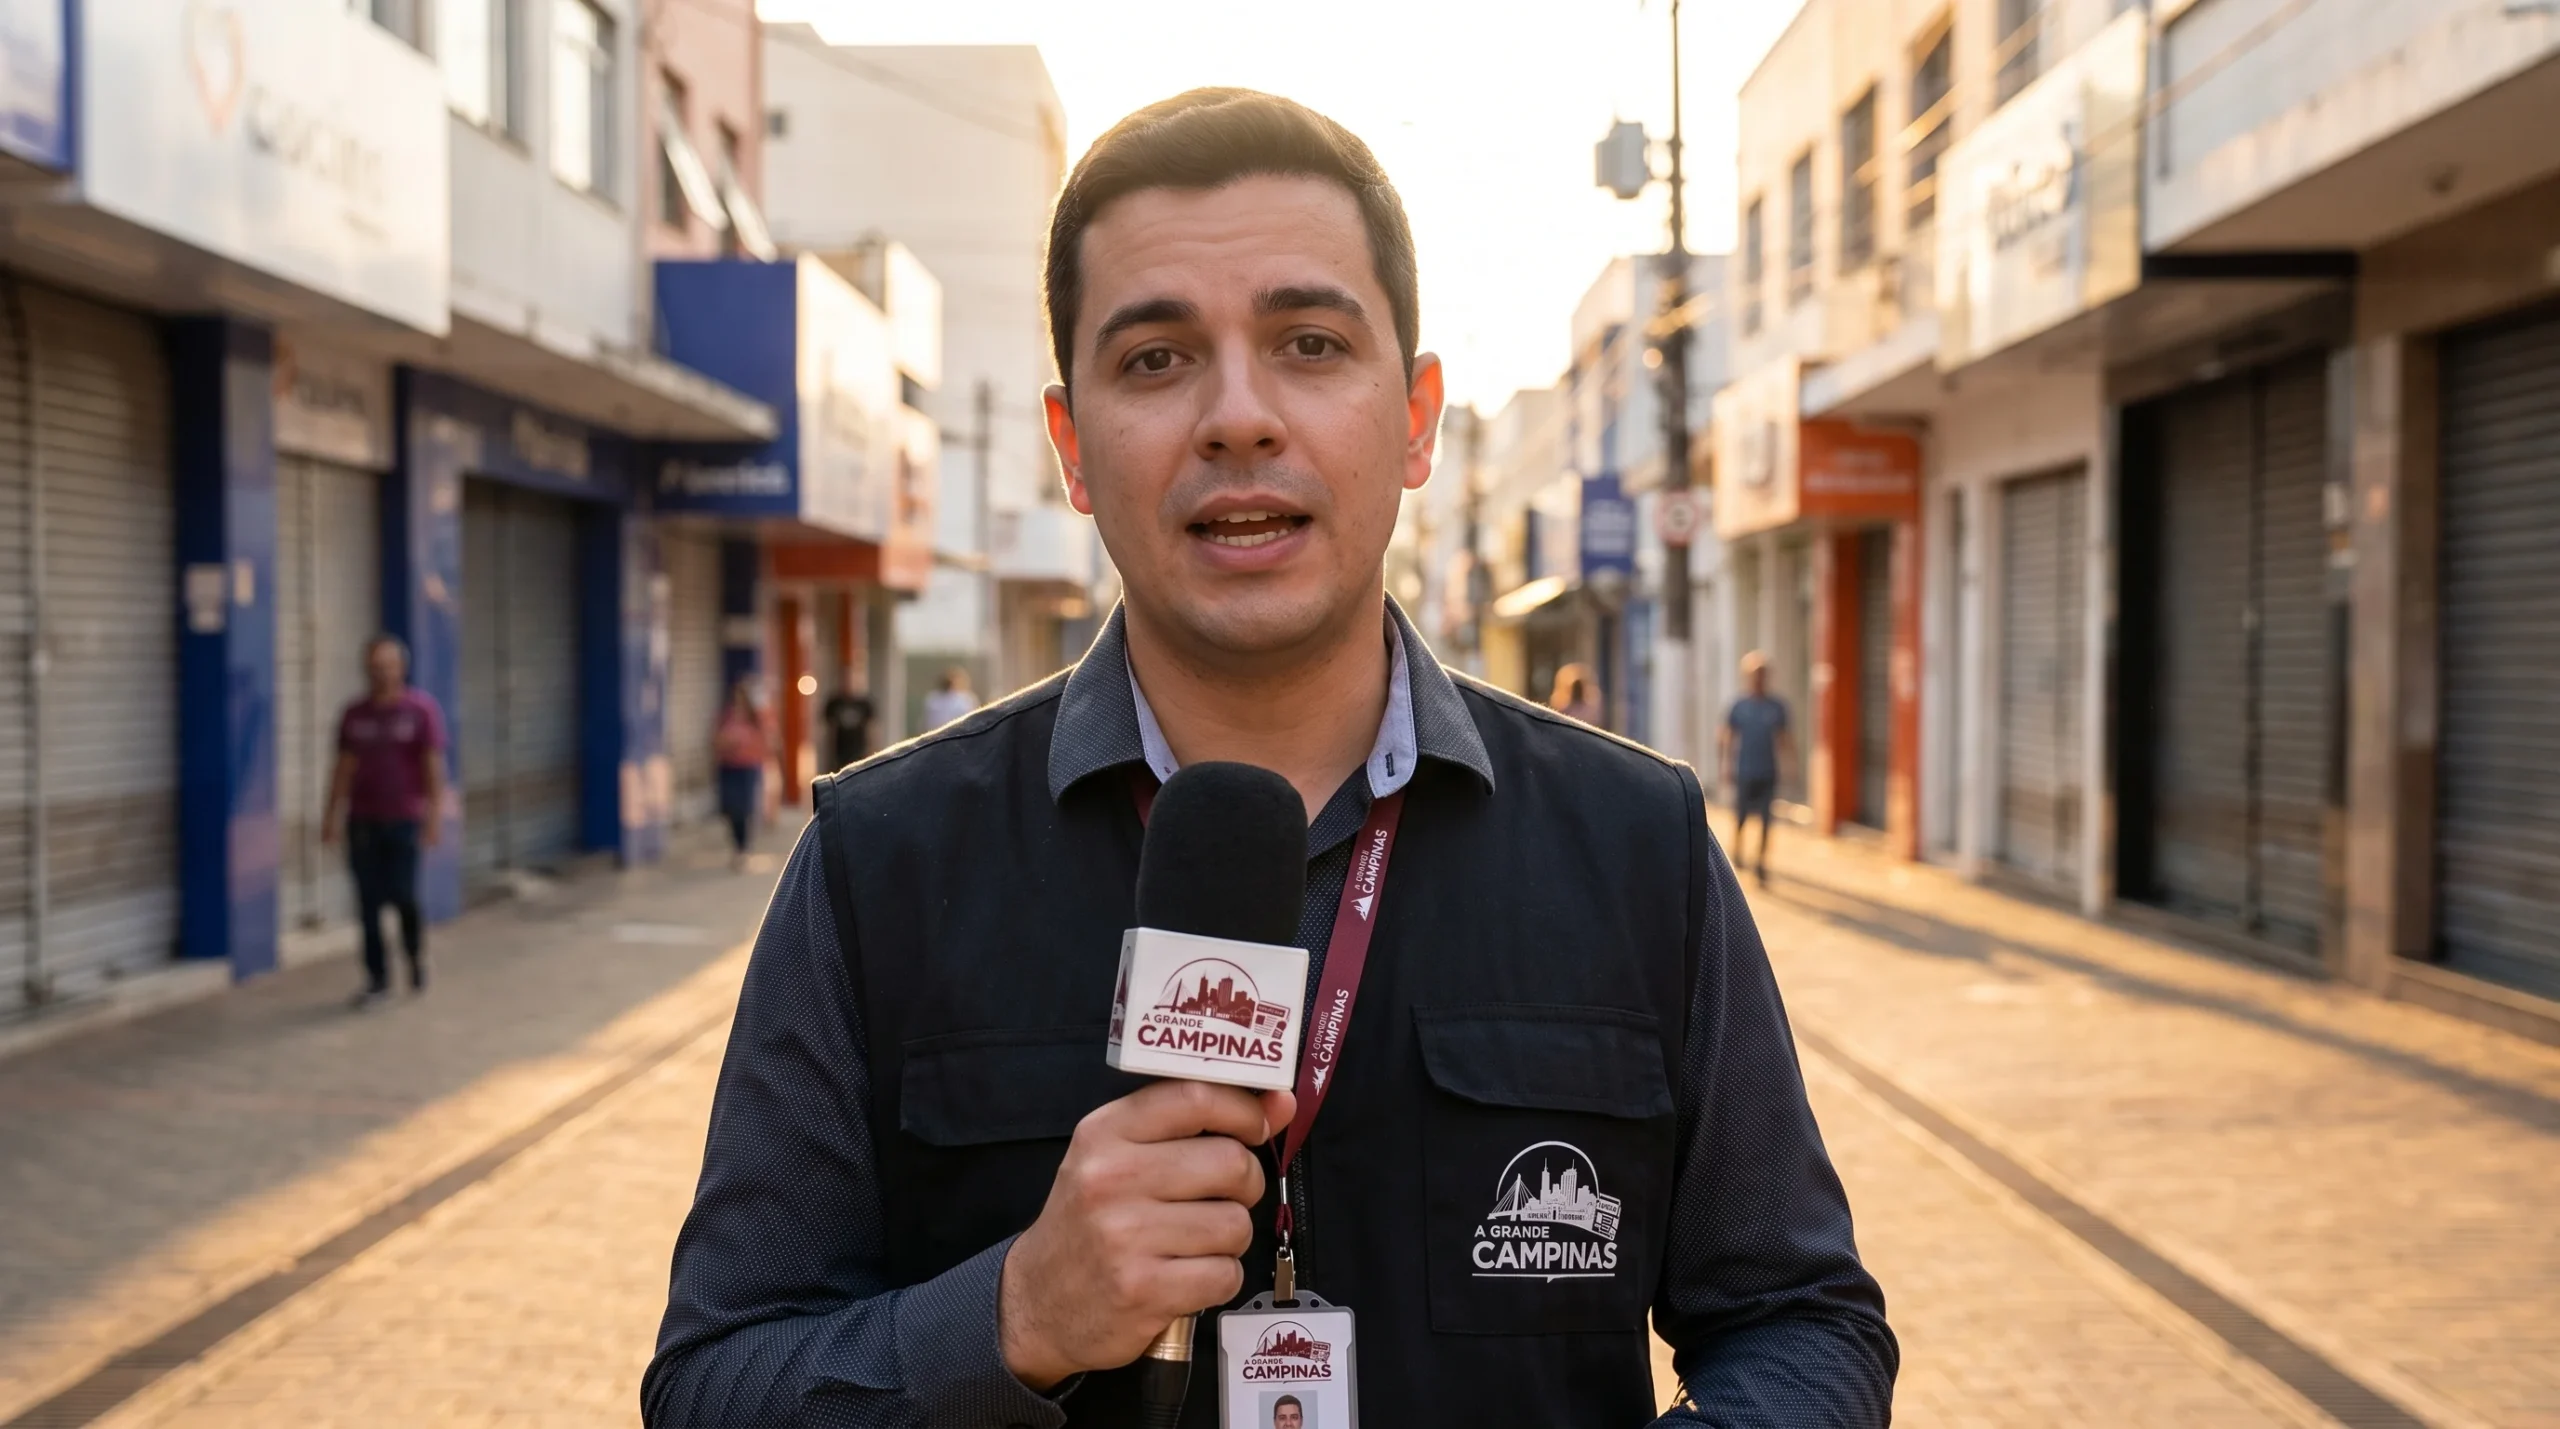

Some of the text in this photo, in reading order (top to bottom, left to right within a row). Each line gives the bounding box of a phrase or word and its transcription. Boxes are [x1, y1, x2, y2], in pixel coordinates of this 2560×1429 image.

[1362, 829, 1388, 894] CAMPINAS
[1141, 1013, 1151, 1022] A
[1153, 1014, 1204, 1029] GRANDE
[1319, 988, 1349, 1063] CAMPINAS
[1137, 1024, 1283, 1063] CAMPINAS
[1474, 1225, 1550, 1238] A GRANDE
[1472, 1240, 1618, 1270] CAMPINAS
[1242, 1364, 1332, 1380] CAMPINAS
